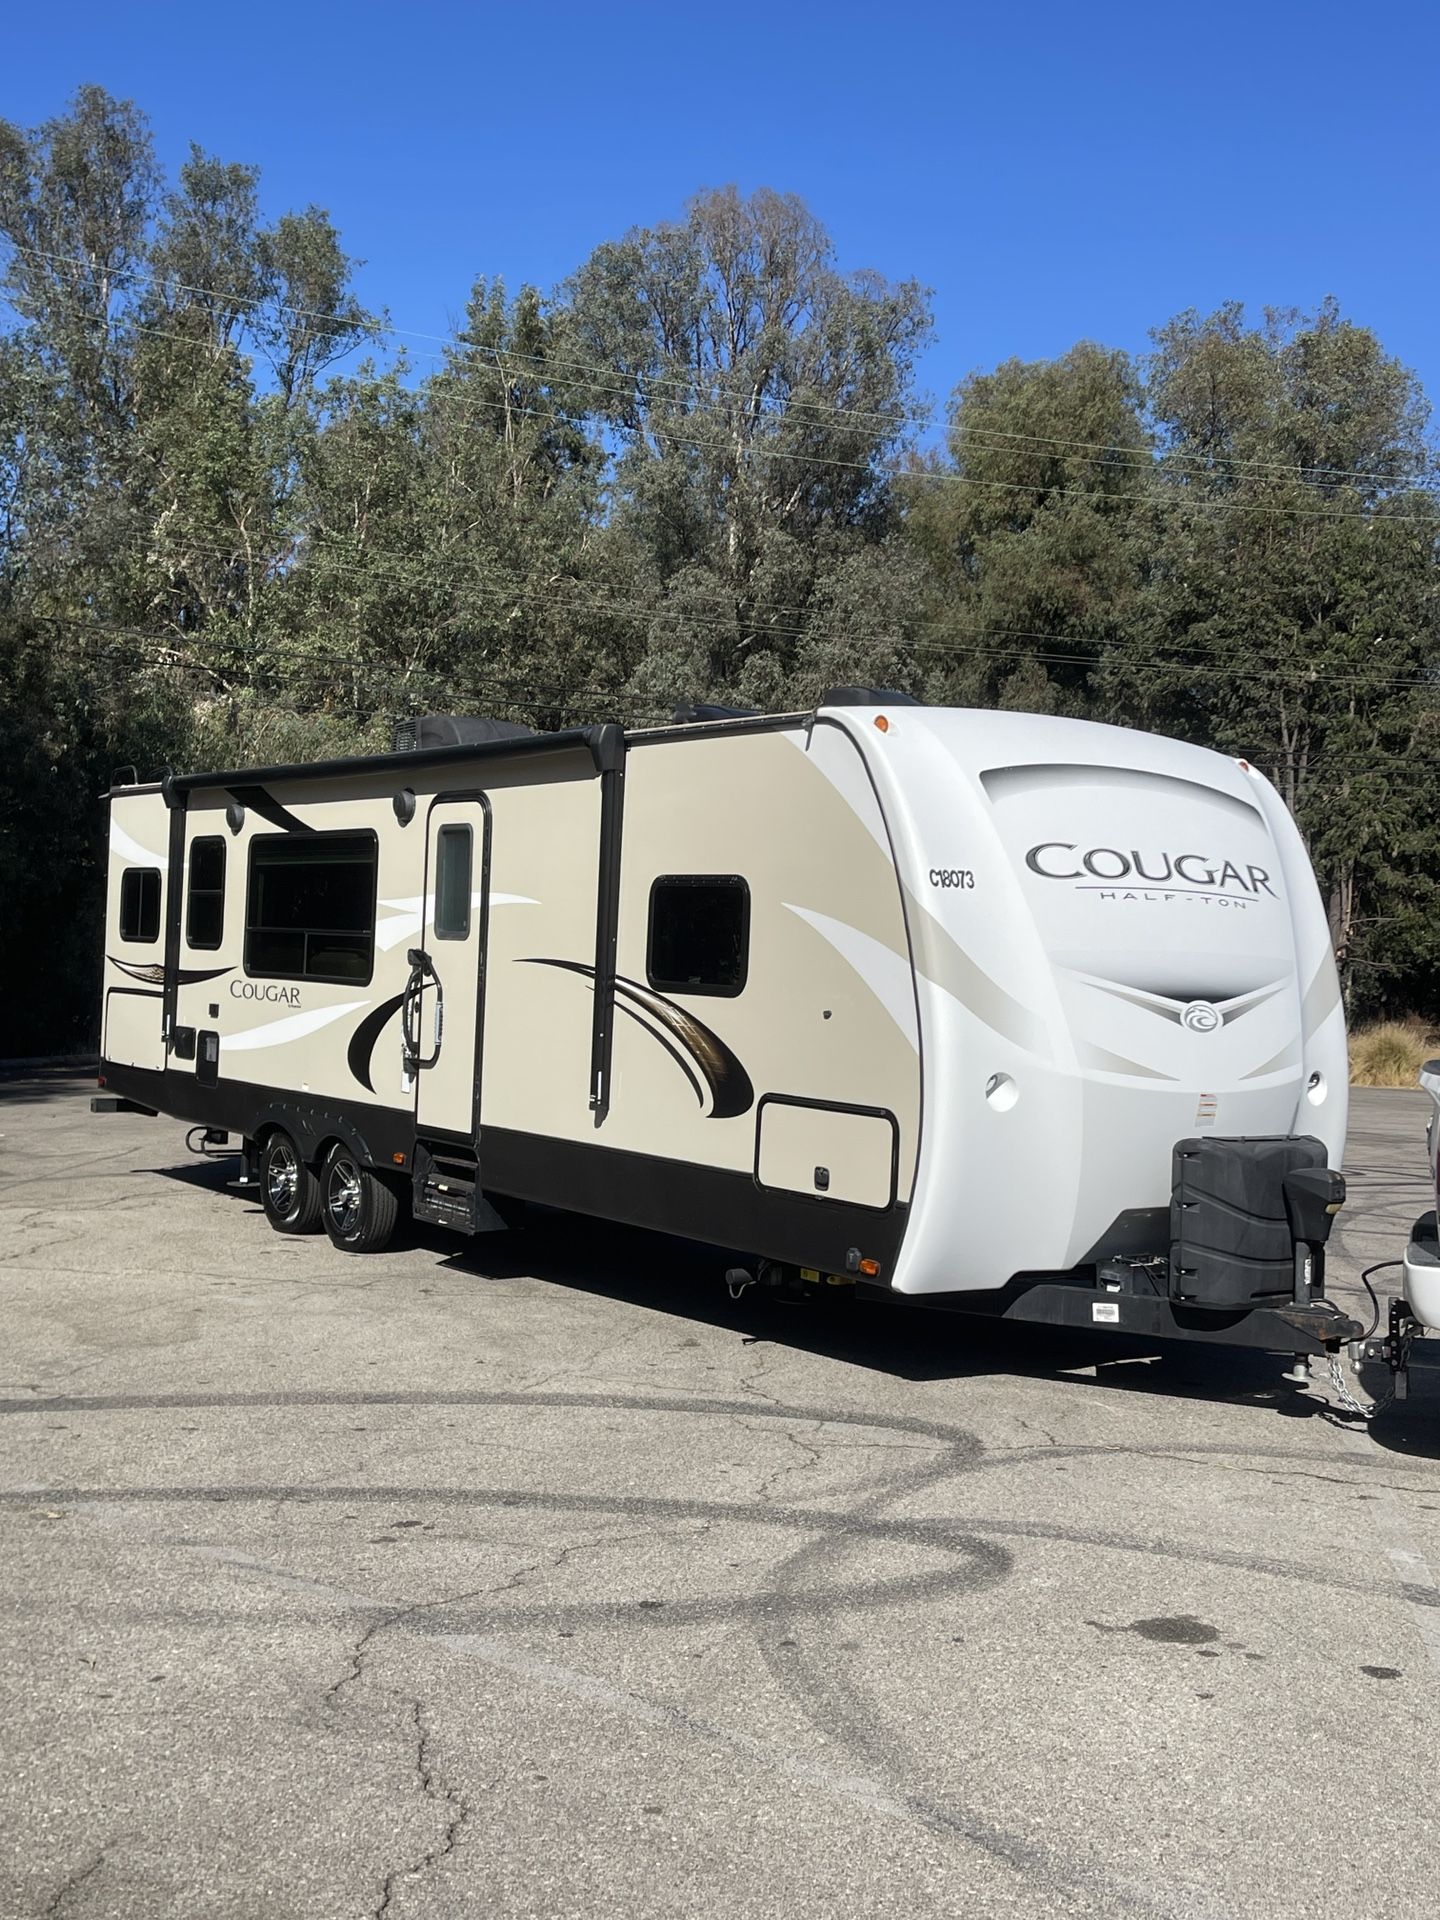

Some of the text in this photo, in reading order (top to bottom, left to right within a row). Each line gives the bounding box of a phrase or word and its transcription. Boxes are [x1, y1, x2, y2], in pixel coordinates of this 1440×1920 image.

[929, 868, 975, 889] C18073
[1025, 842, 1280, 900] COUGAR
[229, 979, 301, 1004] COUGAR
